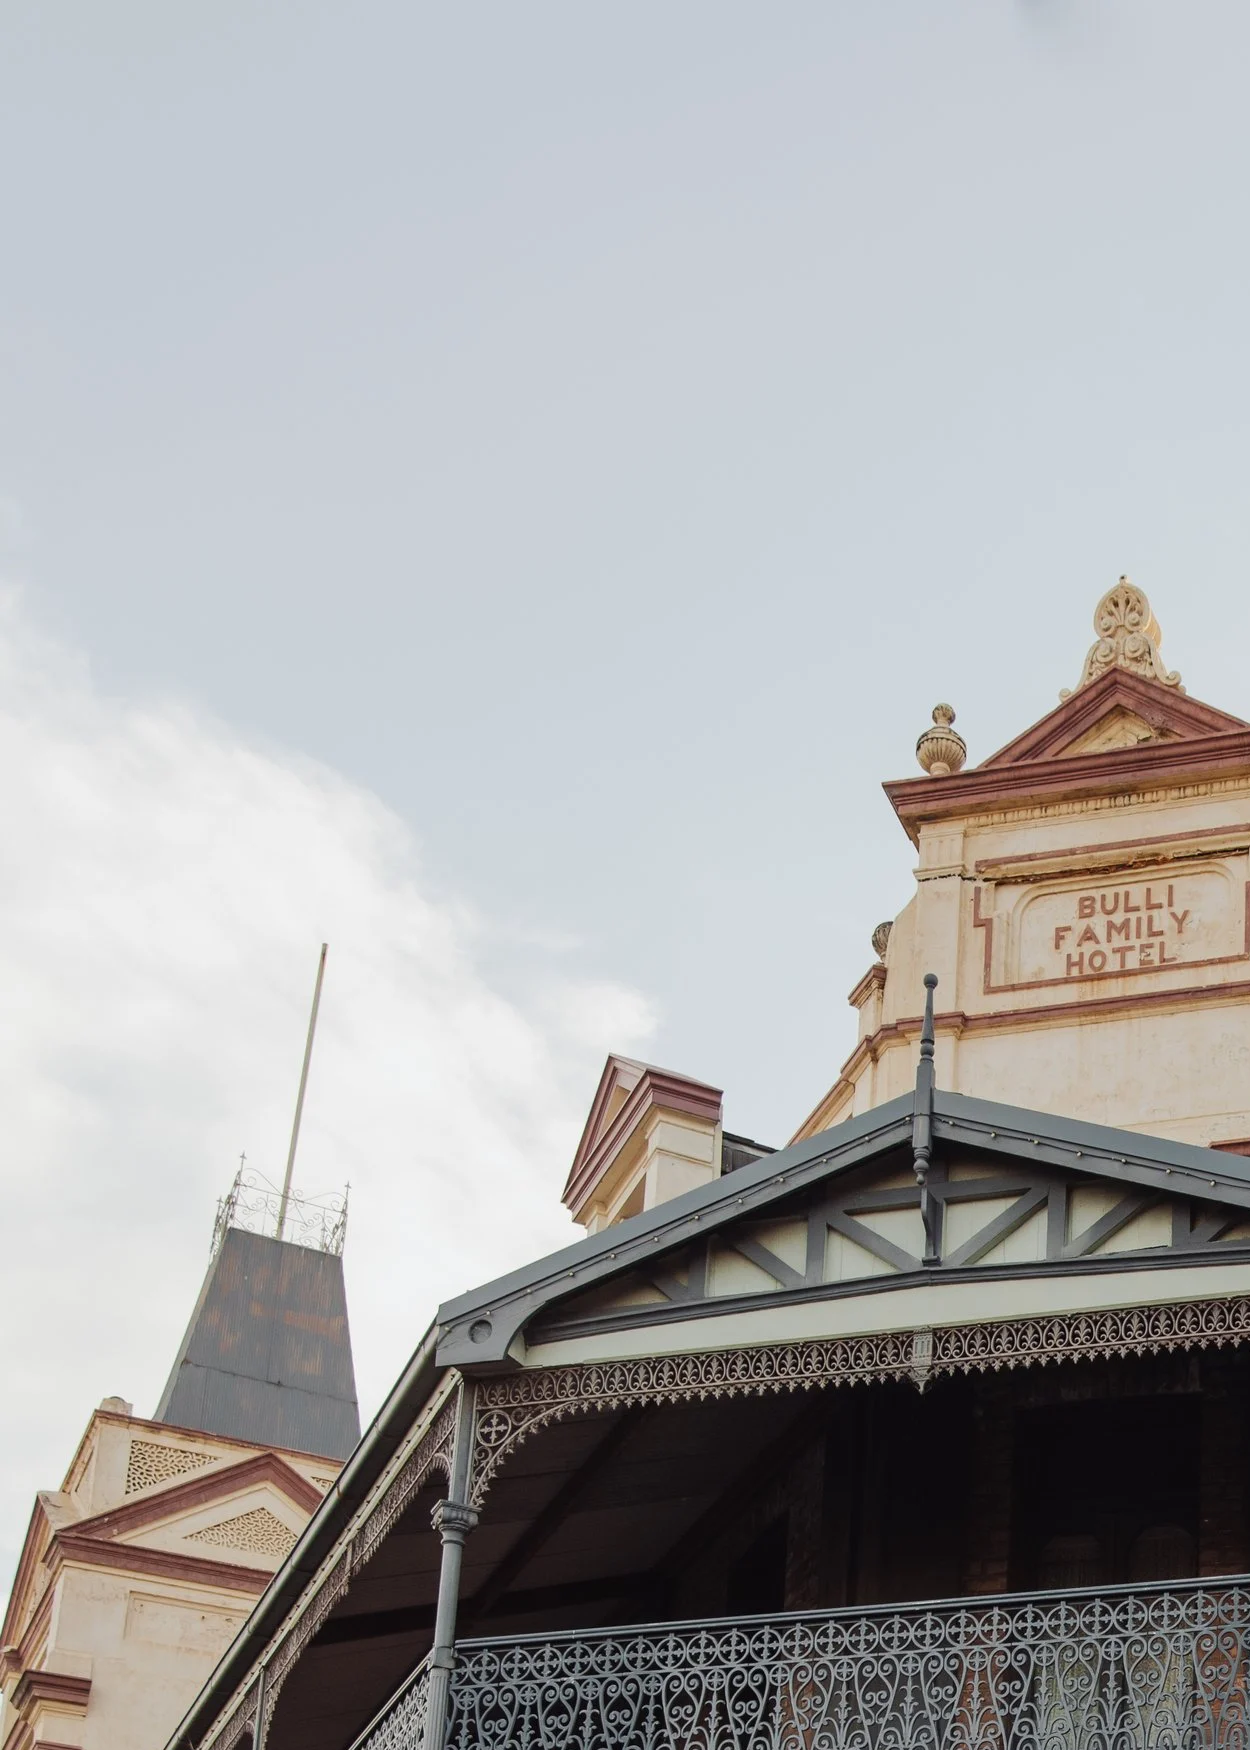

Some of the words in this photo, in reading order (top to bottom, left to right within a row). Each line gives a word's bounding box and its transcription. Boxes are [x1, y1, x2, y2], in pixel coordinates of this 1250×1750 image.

[1078, 884, 1174, 919] BULLI
[1054, 909, 1190, 950] FAMILY
[1066, 940, 1178, 976] HOTEL
